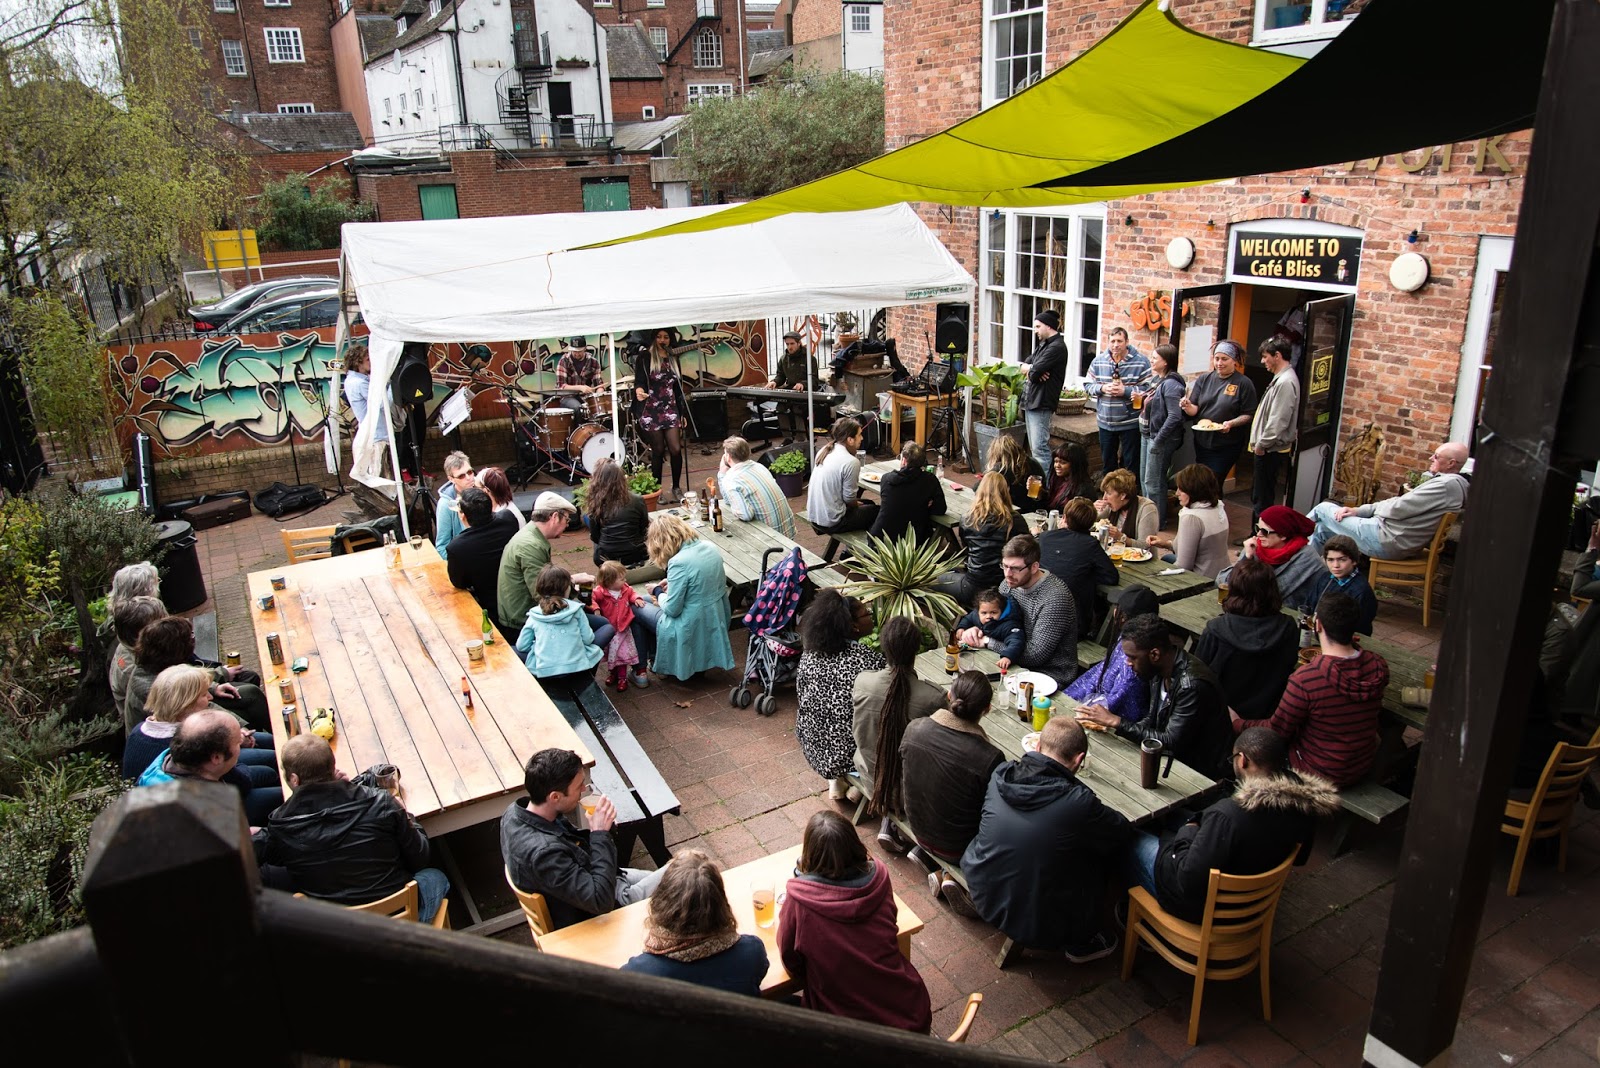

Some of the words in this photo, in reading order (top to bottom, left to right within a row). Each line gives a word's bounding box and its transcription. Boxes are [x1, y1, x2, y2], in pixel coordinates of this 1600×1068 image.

[1240, 238, 1314, 257] WELCOME
[1318, 238, 1340, 257] TO
[1250, 259, 1283, 277] Café
[1286, 259, 1322, 278] Bliss
